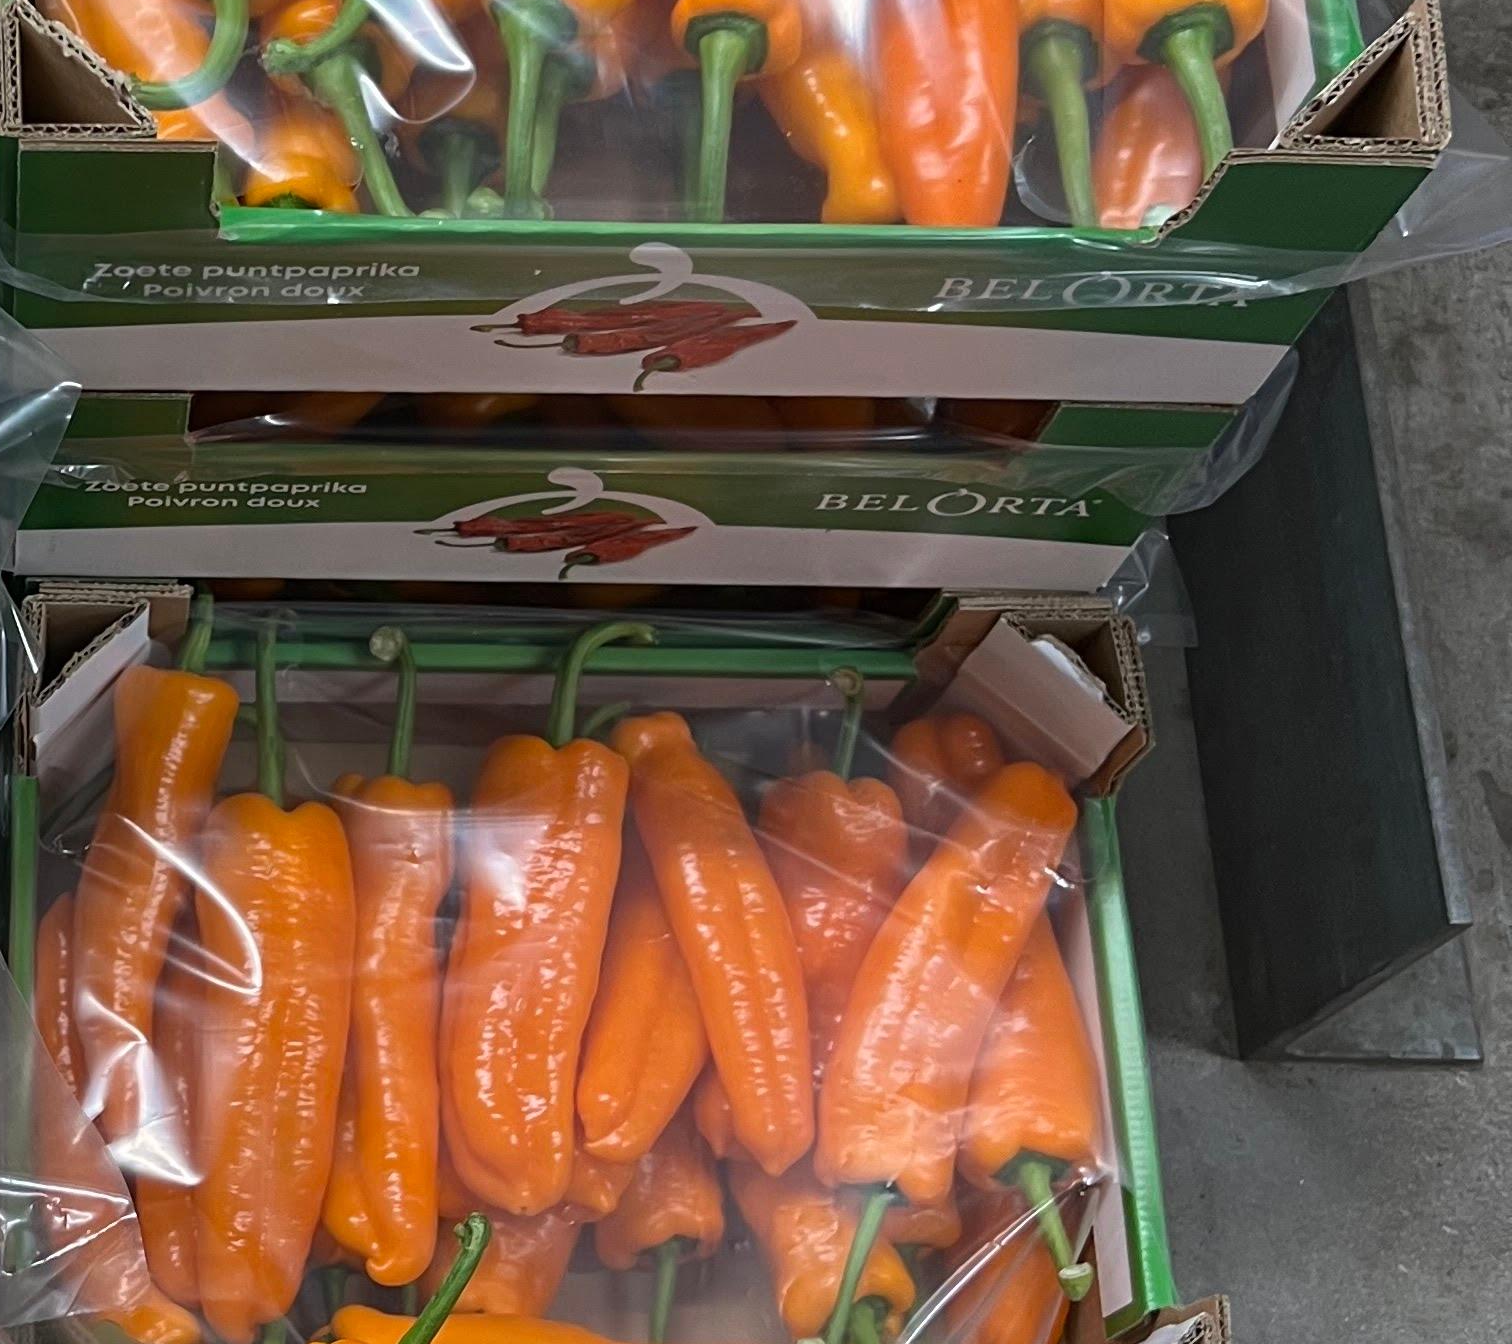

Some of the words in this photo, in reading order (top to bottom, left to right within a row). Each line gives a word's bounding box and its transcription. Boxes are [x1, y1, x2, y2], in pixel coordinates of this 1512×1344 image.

[92, 262, 192, 278] Zoete
[202, 262, 421, 279] puntpaprika
[142, 283, 270, 298] Poivron
[280, 283, 365, 298] doux
[934, 270, 1248, 308] BELORTA
[84, 480, 170, 493] Zoete
[178, 480, 368, 495] puntpaprika
[127, 495, 239, 508] Poivron
[246, 495, 321, 509] doux
[814, 487, 1091, 518] BELORTA
